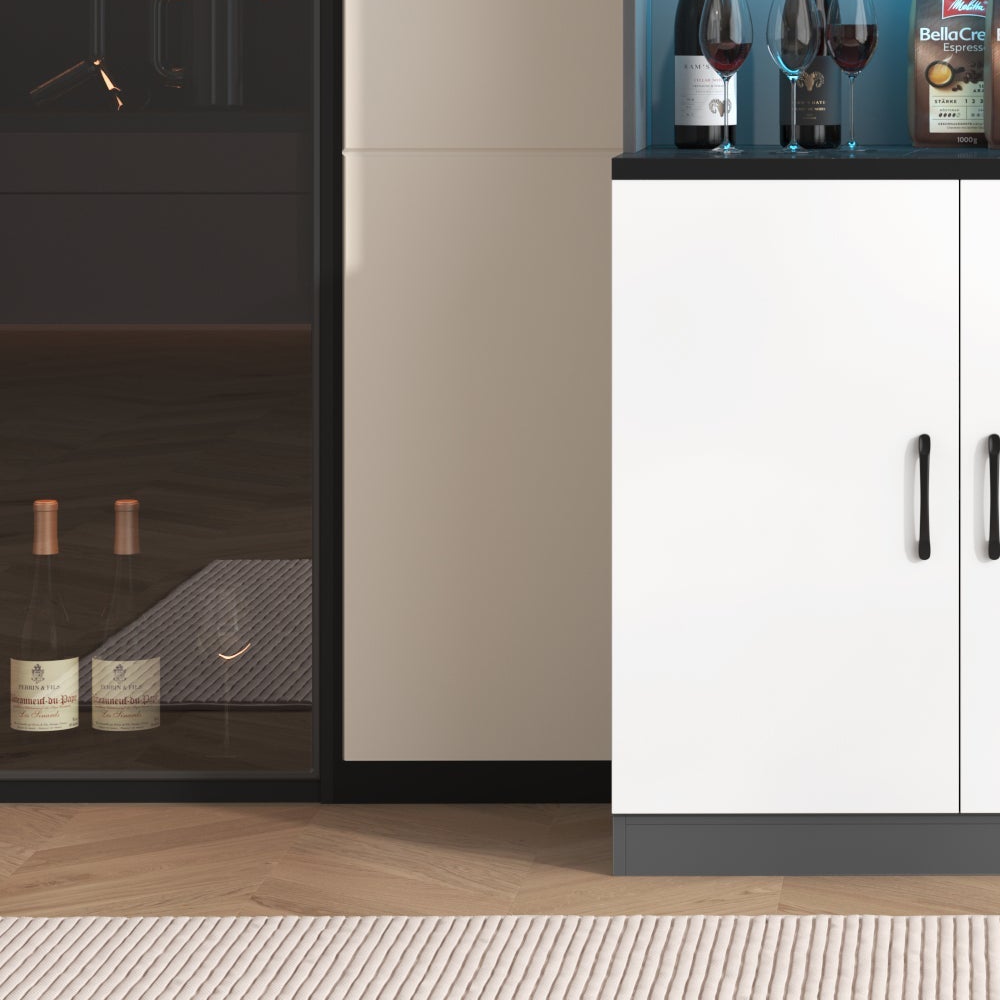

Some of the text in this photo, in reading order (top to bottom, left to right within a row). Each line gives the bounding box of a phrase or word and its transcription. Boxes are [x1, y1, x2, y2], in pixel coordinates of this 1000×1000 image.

[919, 26, 986, 42] BellaCre
[943, 42, 985, 54] Espress
[957, 136, 978, 144] 1000g
